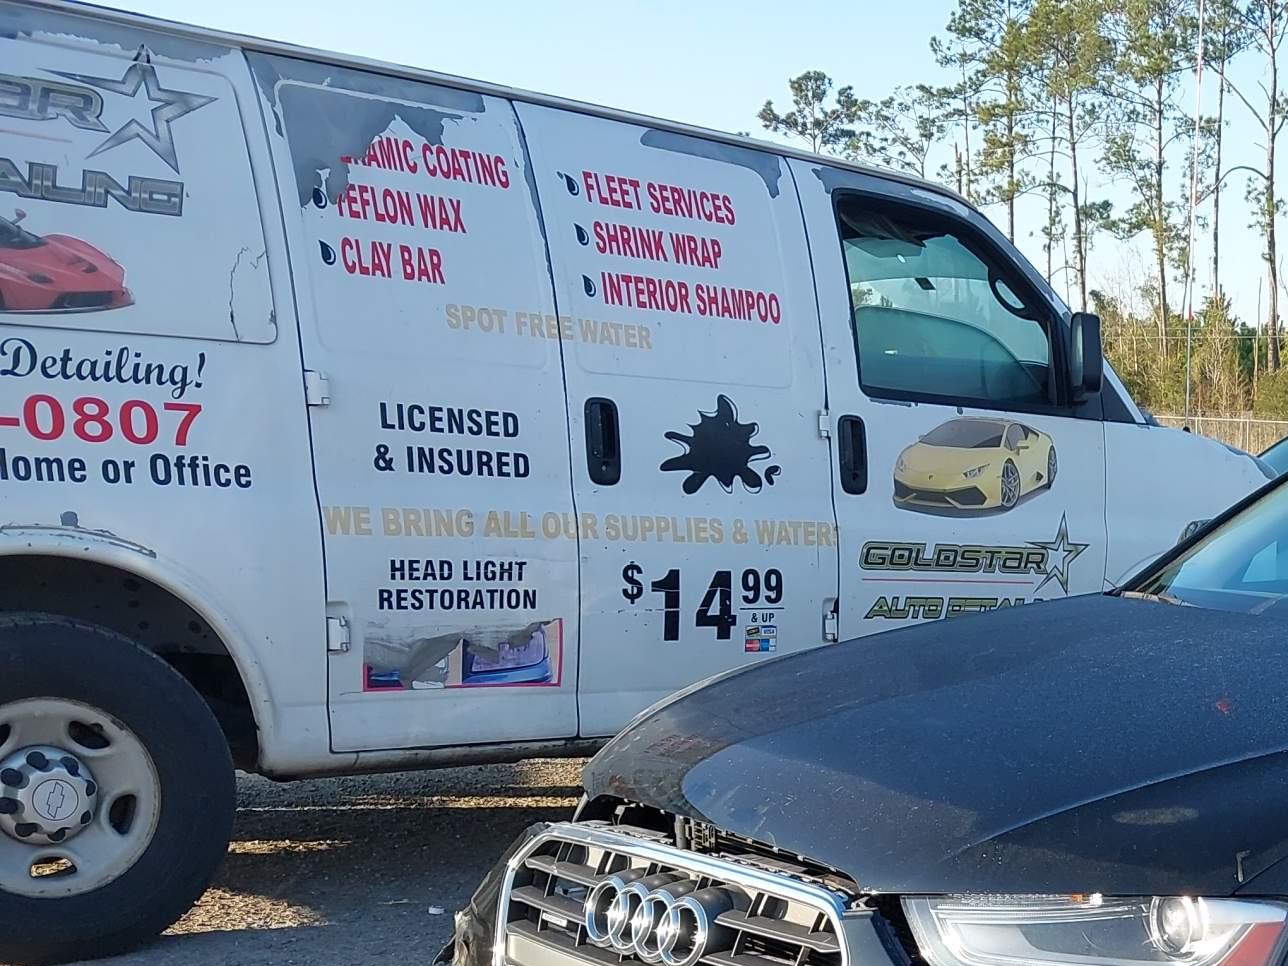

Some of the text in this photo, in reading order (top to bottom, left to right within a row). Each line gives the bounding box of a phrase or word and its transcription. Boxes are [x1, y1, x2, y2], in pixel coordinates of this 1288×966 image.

[422, 142, 510, 189] COATING
[337, 183, 467, 233] TEFLON WAX
[582, 171, 736, 225] FLEET SERVICES
[341, 237, 445, 284] CLAY BAR
[593, 221, 722, 269] SHRINK WRAP
[601, 271, 781, 324] INTERIOR SHAMPOO
[446, 303, 653, 350] SPOT FREE WATER
[1, 338, 206, 399] Detailing!
[380, 402, 520, 438] LICENSED
[0, 448, 252, 489] ome or Office
[374, 444, 530, 478] & INSURED
[323, 506, 373, 536] WE
[382, 507, 474, 538] BRING
[484, 510, 536, 539] ALL
[542, 511, 599, 540] OUR
[605, 514, 724, 544] SUPPLIES
[732, 519, 749, 544] &
[390, 559, 527, 582] HEAD LIGHT
[378, 588, 537, 610] RESTORATION
[751, 612, 775, 623] & UP
[864, 597, 944, 619] AUTO
